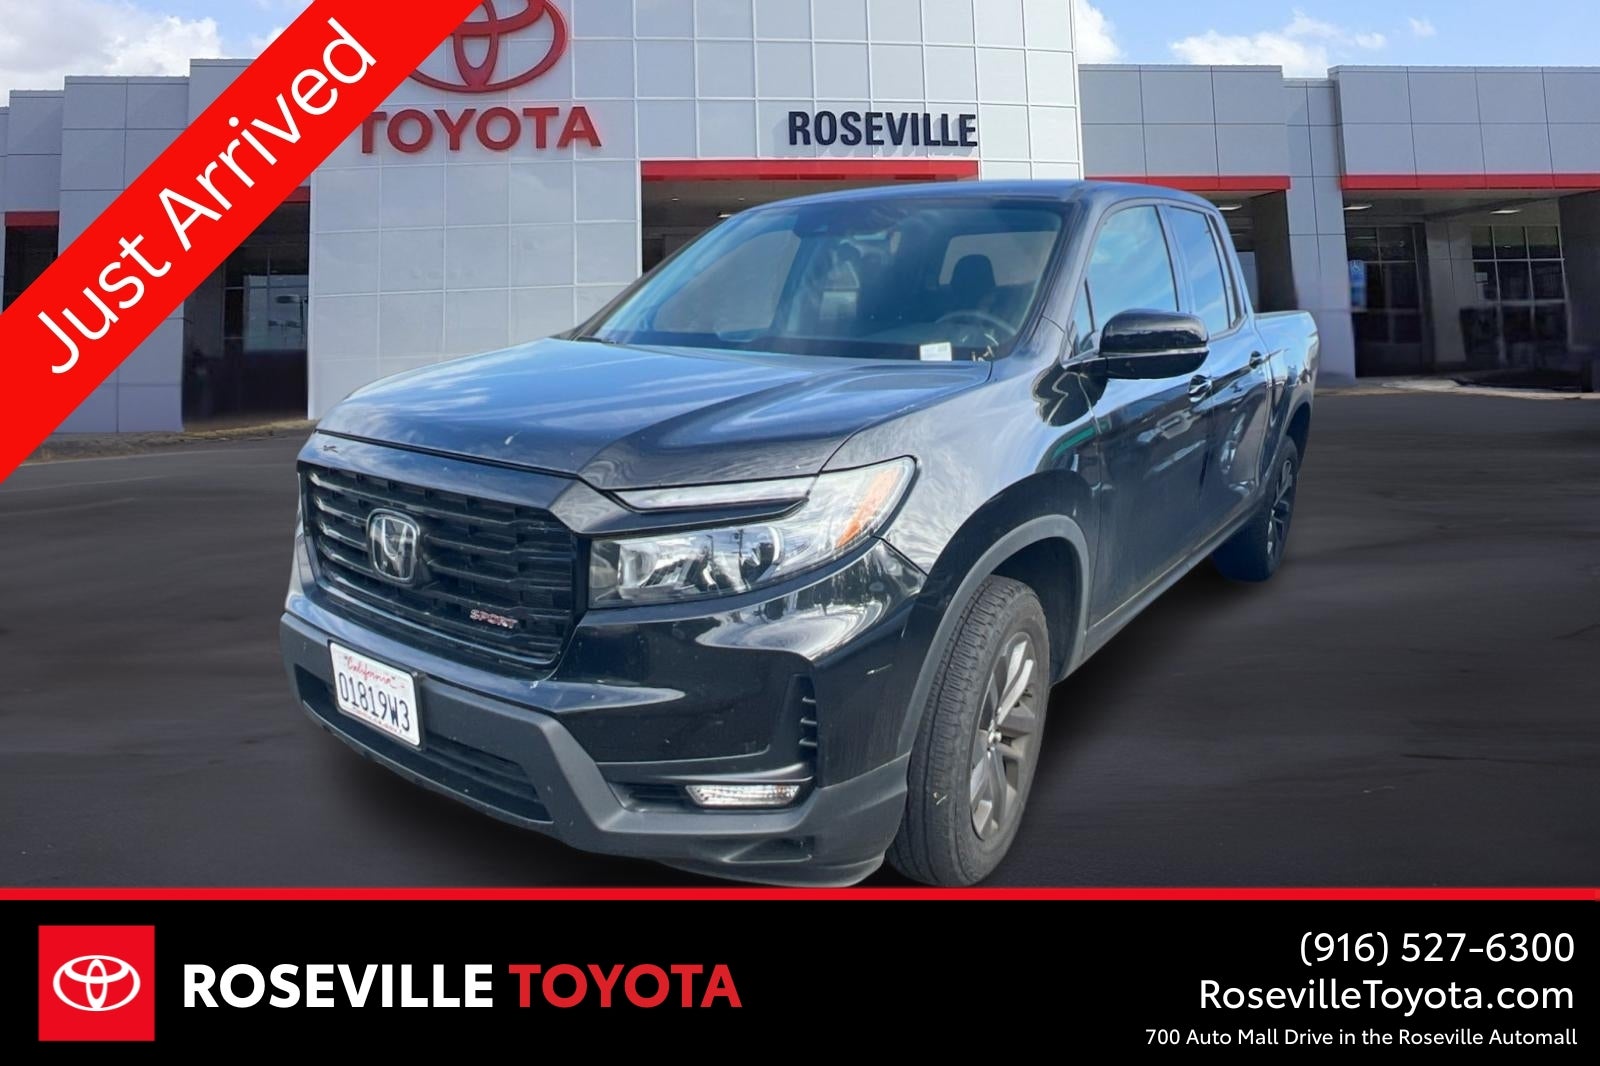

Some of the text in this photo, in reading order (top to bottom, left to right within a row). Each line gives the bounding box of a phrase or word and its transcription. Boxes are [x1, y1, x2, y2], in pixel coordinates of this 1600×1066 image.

[361, 106, 602, 153] TOYOTA
[788, 111, 978, 147] ROSEVILLE
[470, 609, 518, 629] SPORT
[338, 671, 410, 732] 01819W3
